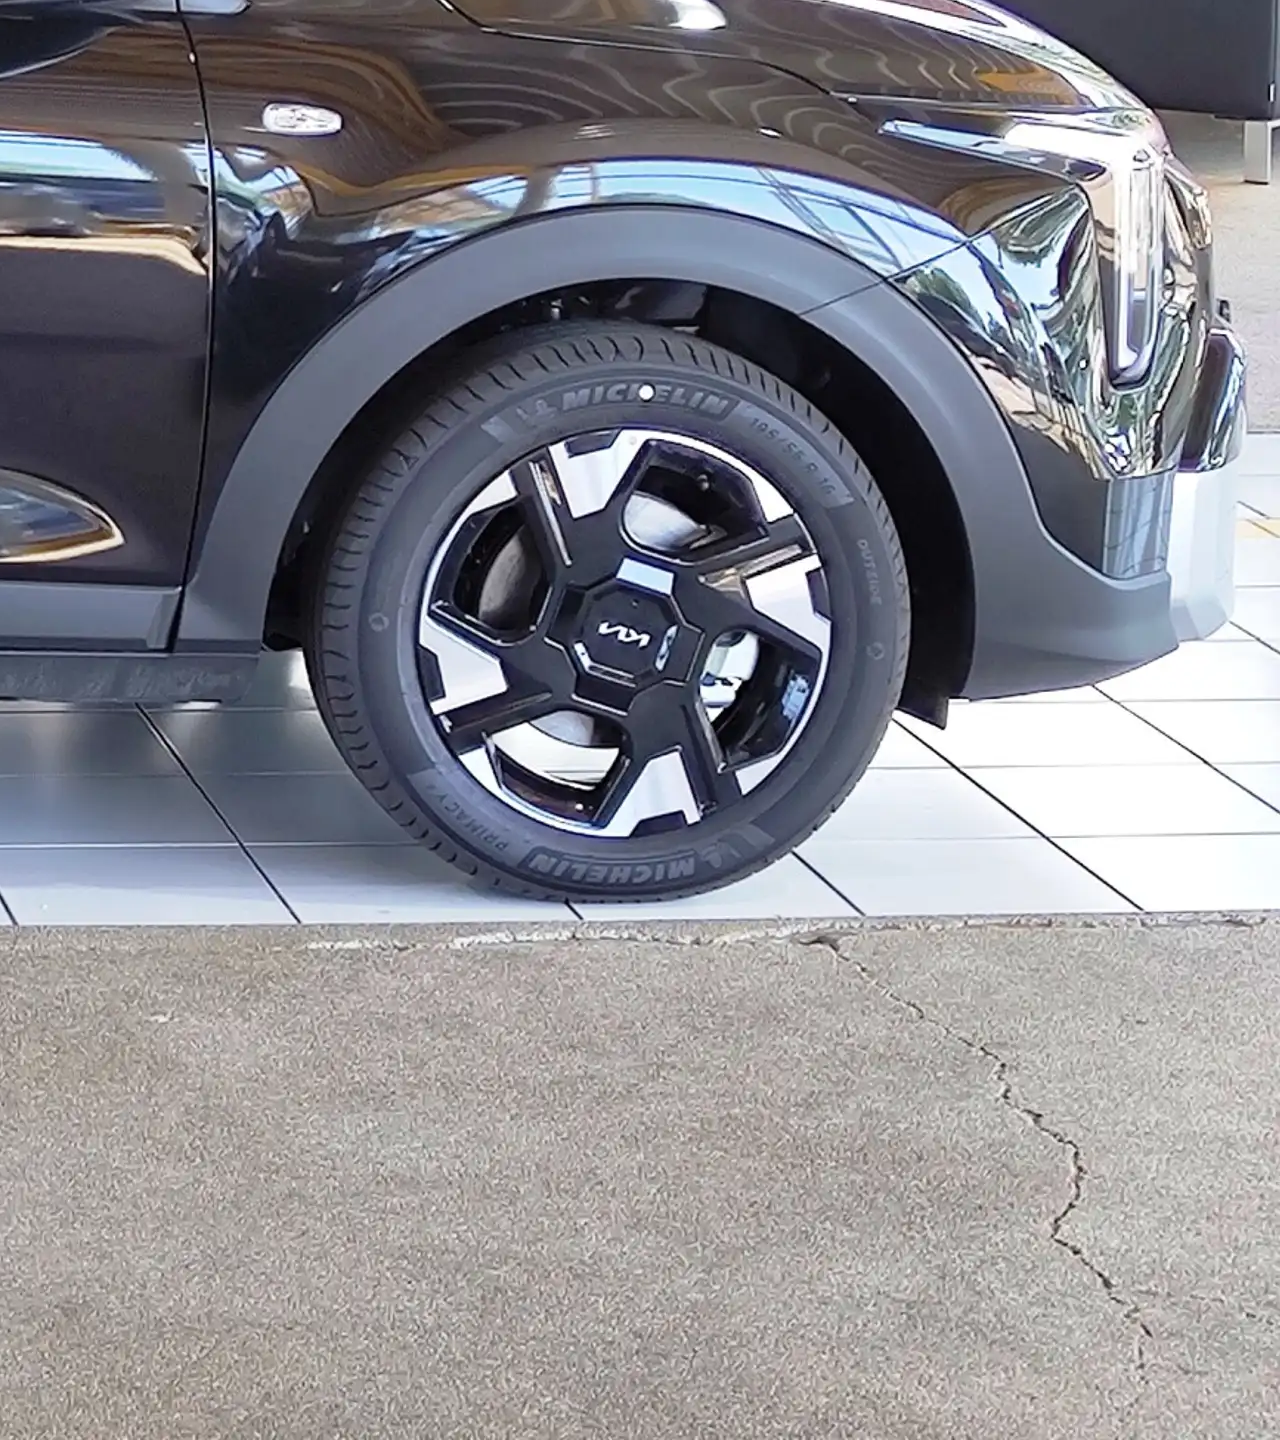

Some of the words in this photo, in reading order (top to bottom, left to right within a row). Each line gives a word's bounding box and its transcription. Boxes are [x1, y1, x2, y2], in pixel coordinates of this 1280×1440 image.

[856, 538, 884, 607] OUTSIDE
[436, 792, 509, 851] PRIMACY
[528, 853, 697, 886] MICHELIN
